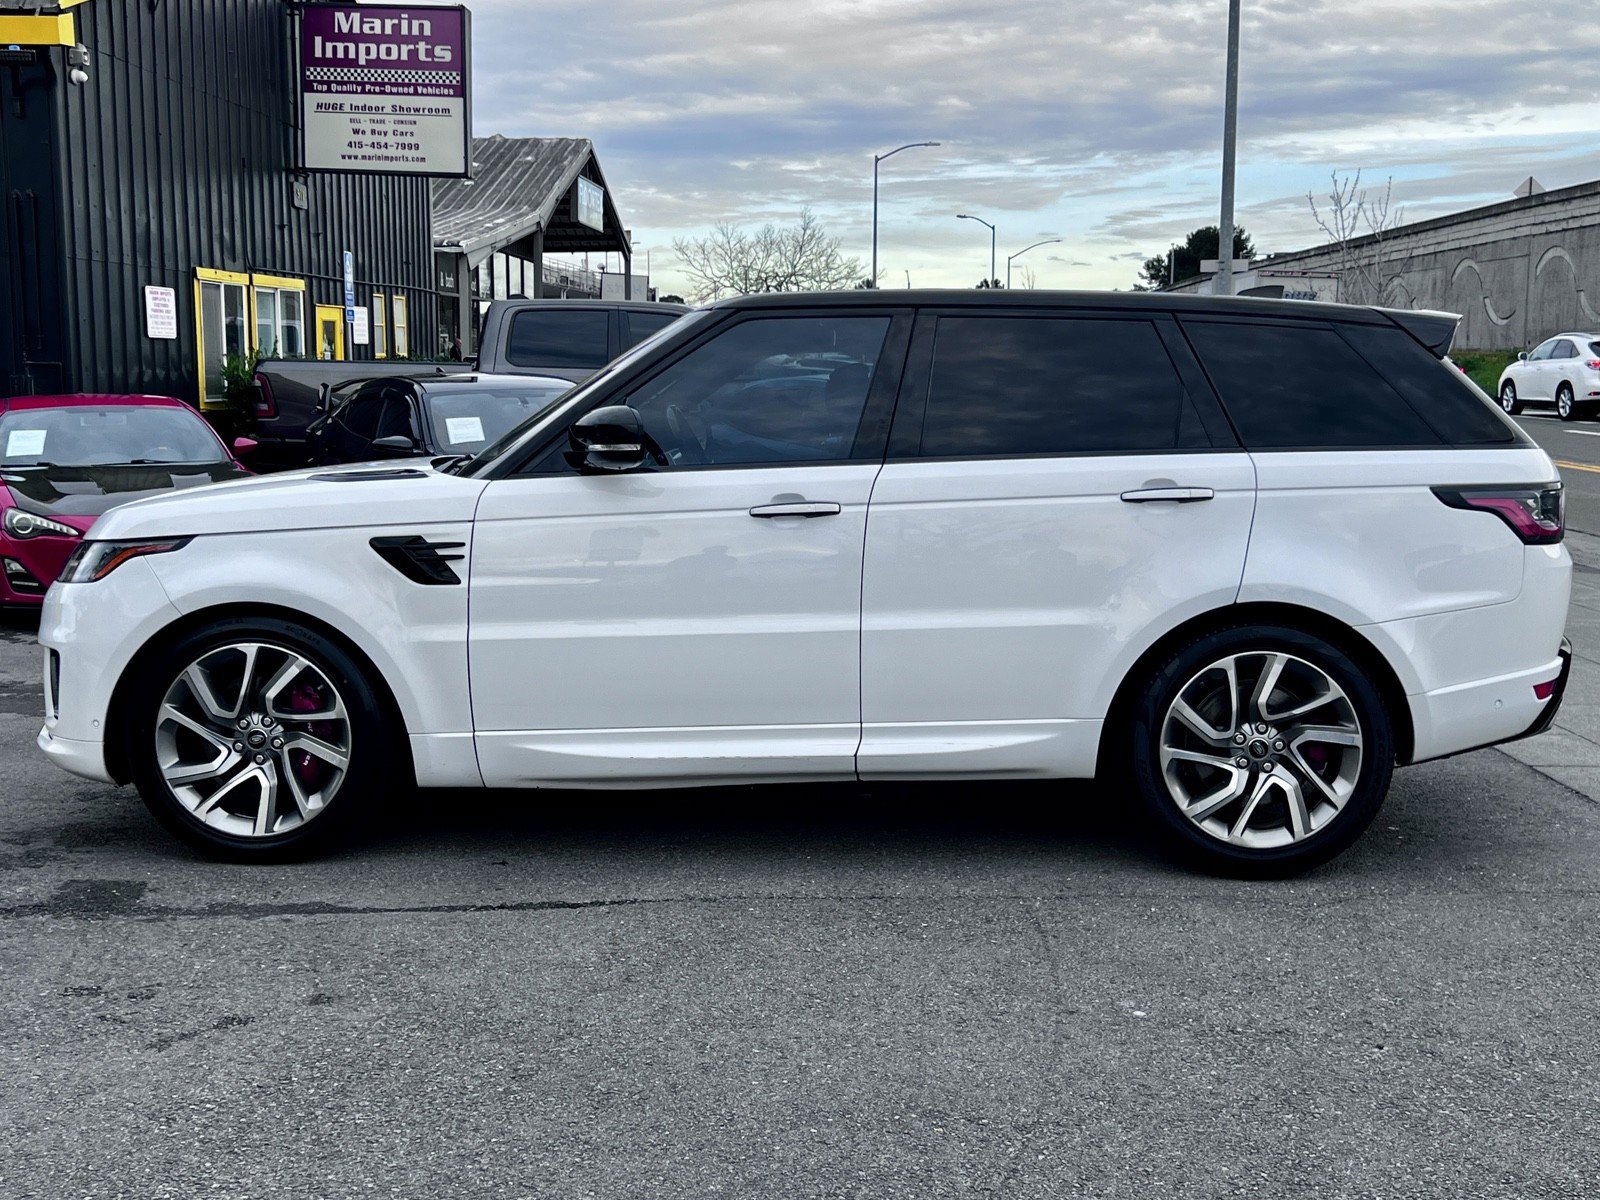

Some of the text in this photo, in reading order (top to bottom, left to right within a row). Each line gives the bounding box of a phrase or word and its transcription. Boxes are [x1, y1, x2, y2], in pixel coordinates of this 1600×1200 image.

[334, 11, 432, 36] Marin
[314, 35, 452, 65] Imports
[313, 83, 454, 95] Top Quality Pre-Owned Vehicles
[316, 102, 451, 114] HUGE Indoor Showroom
[370, 129, 388, 137] Buy
[392, 129, 415, 137] Cars
[347, 141, 420, 151] 415-454-7999
[341, 153, 426, 163] www.marinimports.com
